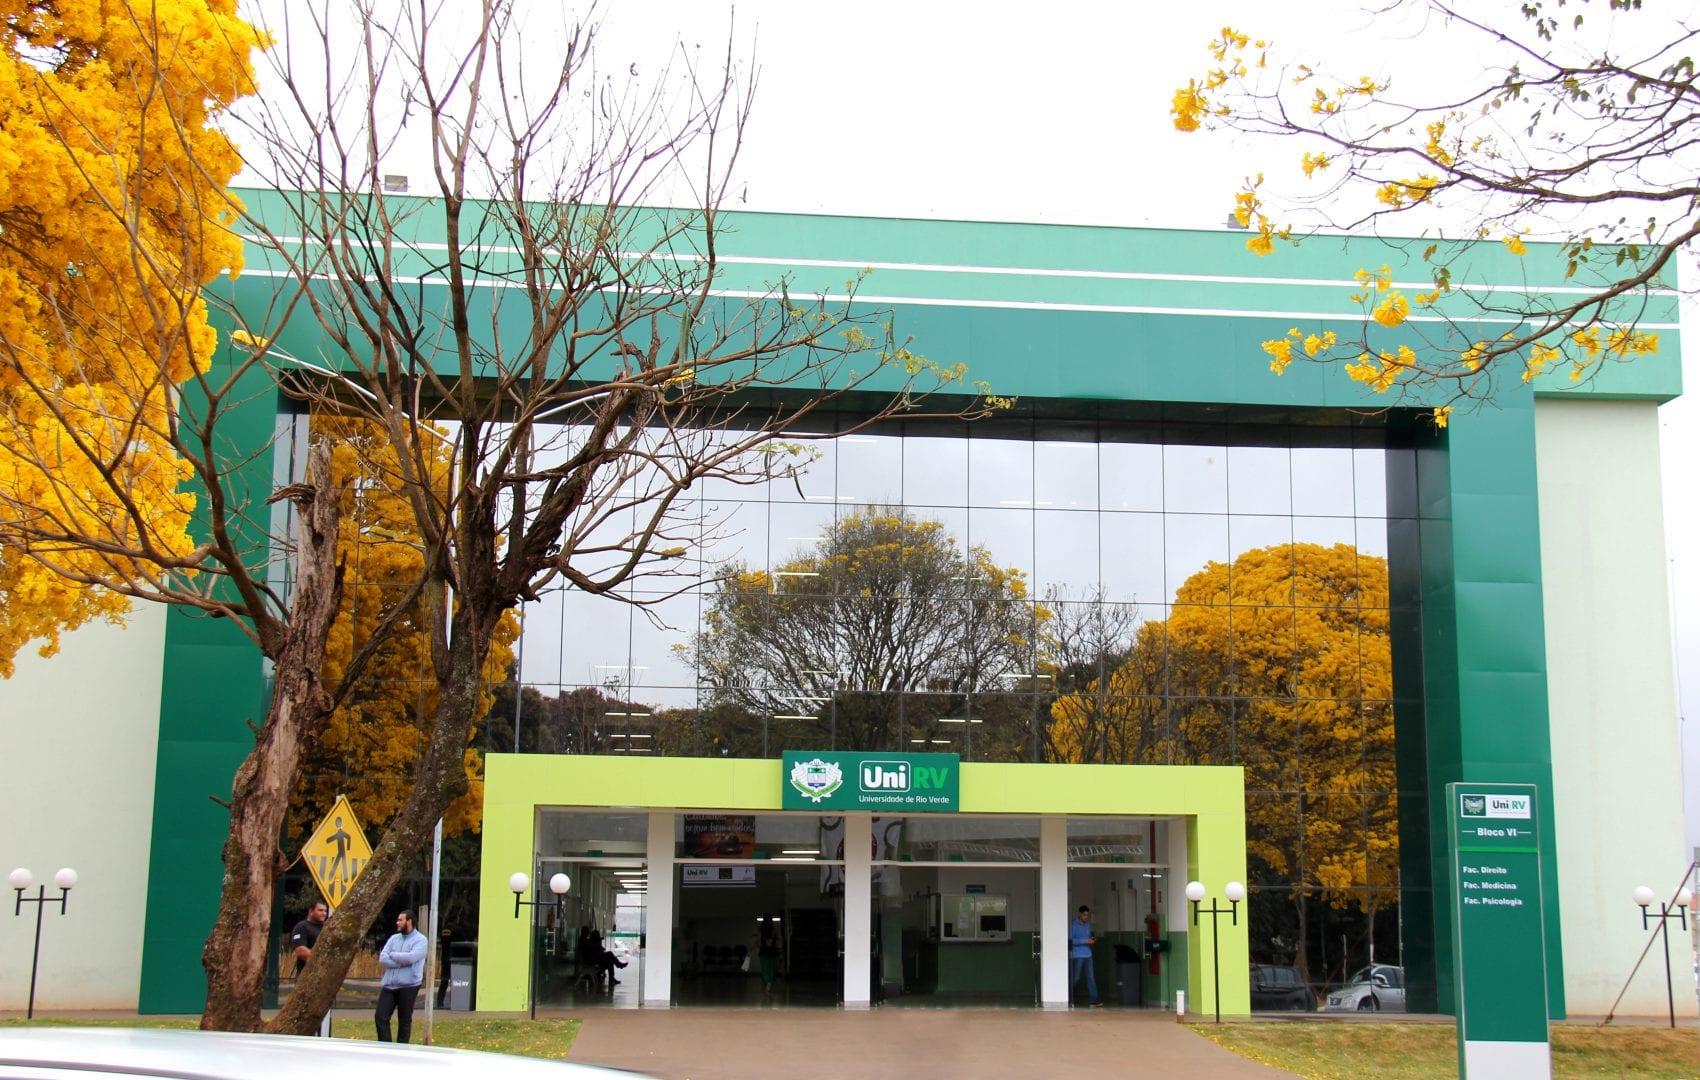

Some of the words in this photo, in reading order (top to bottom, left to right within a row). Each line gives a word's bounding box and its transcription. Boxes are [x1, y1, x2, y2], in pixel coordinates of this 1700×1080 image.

[864, 765, 906, 788] Uni
[913, 767, 949, 788] RV
[859, 795, 904, 803] Universidade
[905, 795, 914, 803] de
[928, 796, 949, 804] Verde
[1492, 800, 1509, 809] Uni
[1512, 800, 1526, 809] RV
[1477, 828, 1505, 836] Bloco
[1506, 828, 1517, 836] VI
[1481, 866, 1507, 874] Direito
[1481, 882, 1517, 890] Medicina
[1482, 897, 1522, 906] Psicologia
